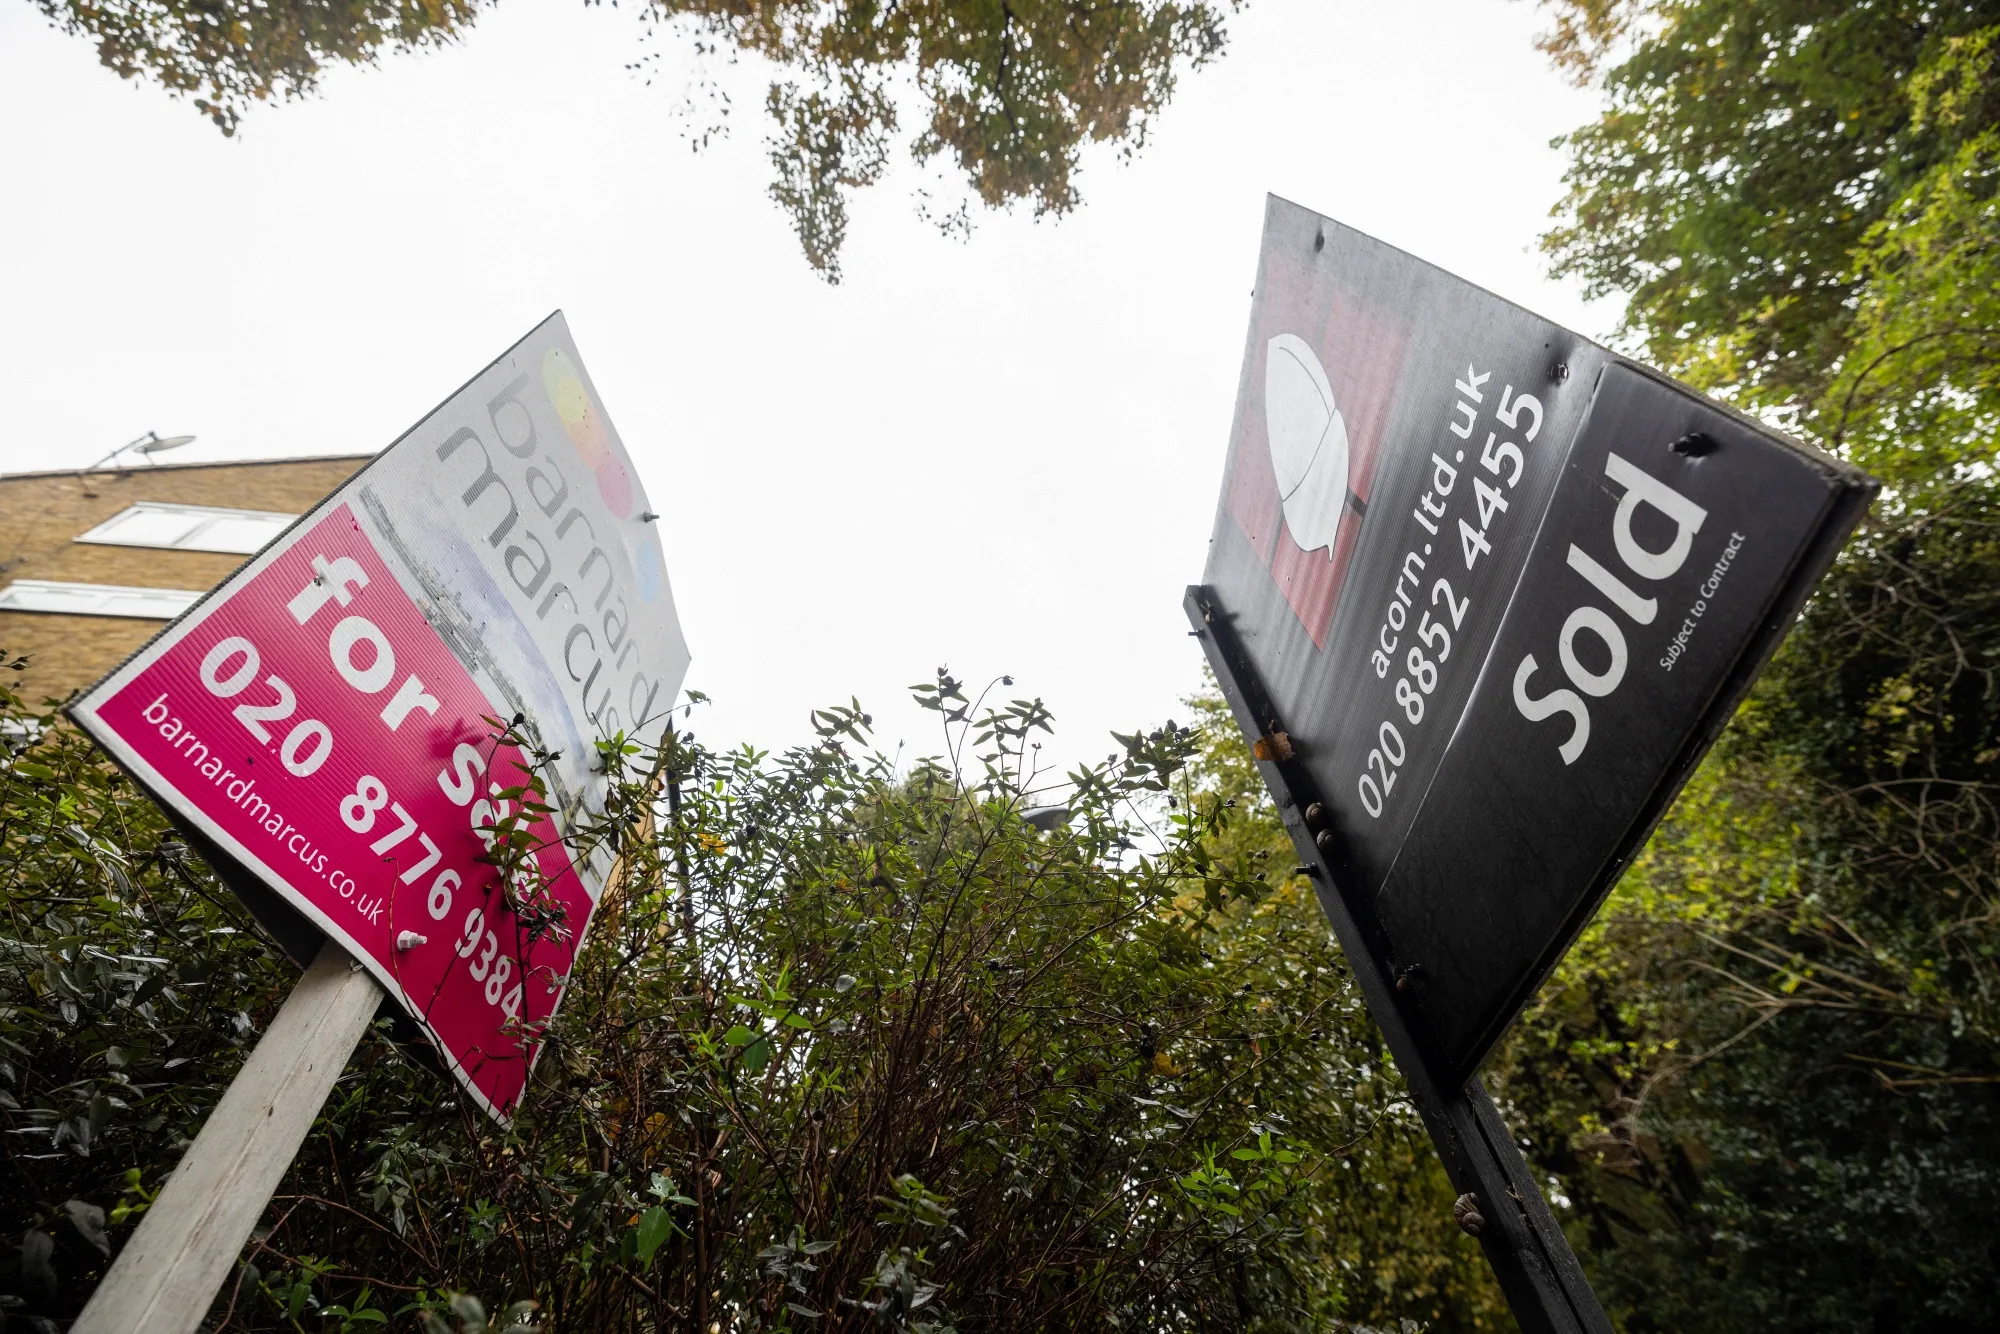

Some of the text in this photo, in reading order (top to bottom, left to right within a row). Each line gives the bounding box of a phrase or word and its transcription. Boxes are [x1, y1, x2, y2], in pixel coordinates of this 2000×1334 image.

[286, 553, 441, 732] for
[487, 371, 660, 732] barnard
[1358, 384, 1544, 819] 020 8852 4455
[1371, 362, 1492, 679] acorn.ltd.uk
[1513, 451, 1709, 766] Sold
[1660, 531, 1747, 672] Subject to Contract
[141, 693, 384, 927] barnardmarcus.co.uk
[199, 636, 524, 1027] 020 8776 9384
